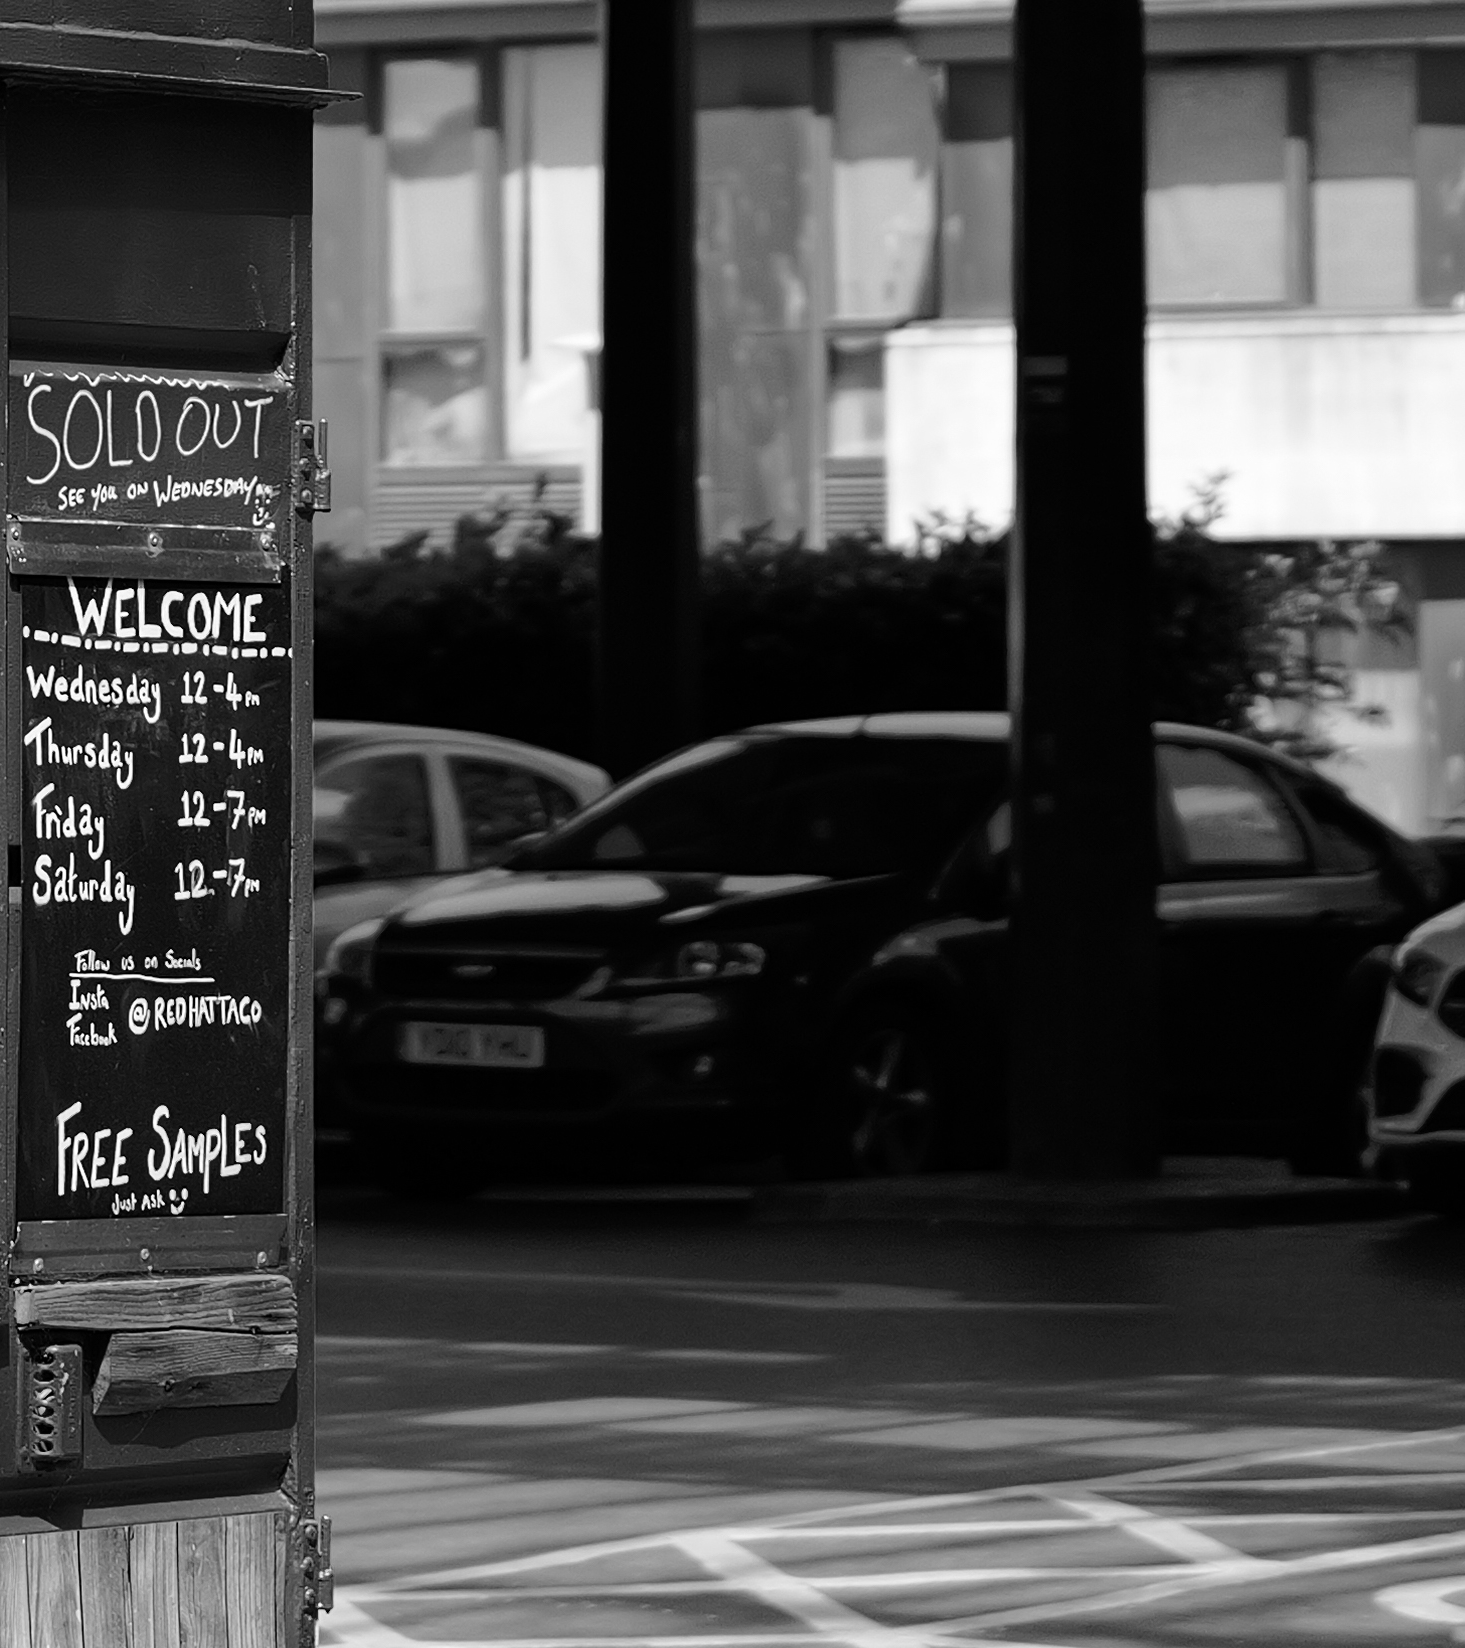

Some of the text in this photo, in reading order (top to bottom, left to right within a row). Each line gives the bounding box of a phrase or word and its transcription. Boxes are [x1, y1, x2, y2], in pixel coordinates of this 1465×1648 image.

[26, 384, 274, 485] SOLD OUT
[58, 485, 85, 511] SEE
[126, 481, 149, 500] ON
[153, 474, 258, 507] WEDNESDAY
[65, 576, 267, 643] WELCOME
[25, 663, 162, 724] Wednesday
[23, 716, 134, 789] Thursday
[33, 782, 105, 860] Friday
[32, 852, 136, 936] Saturday
[74, 948, 110, 973] Follow
[144, 955, 158, 970] on
[164, 947, 202, 971] Socials
[68, 979, 110, 1011] Insta
[128, 994, 263, 1036] @REDHATTACO
[66, 1012, 118, 1047] Facebook
[56, 1100, 267, 1197] FREE SAMPLES
[111, 1192, 138, 1215] Just
